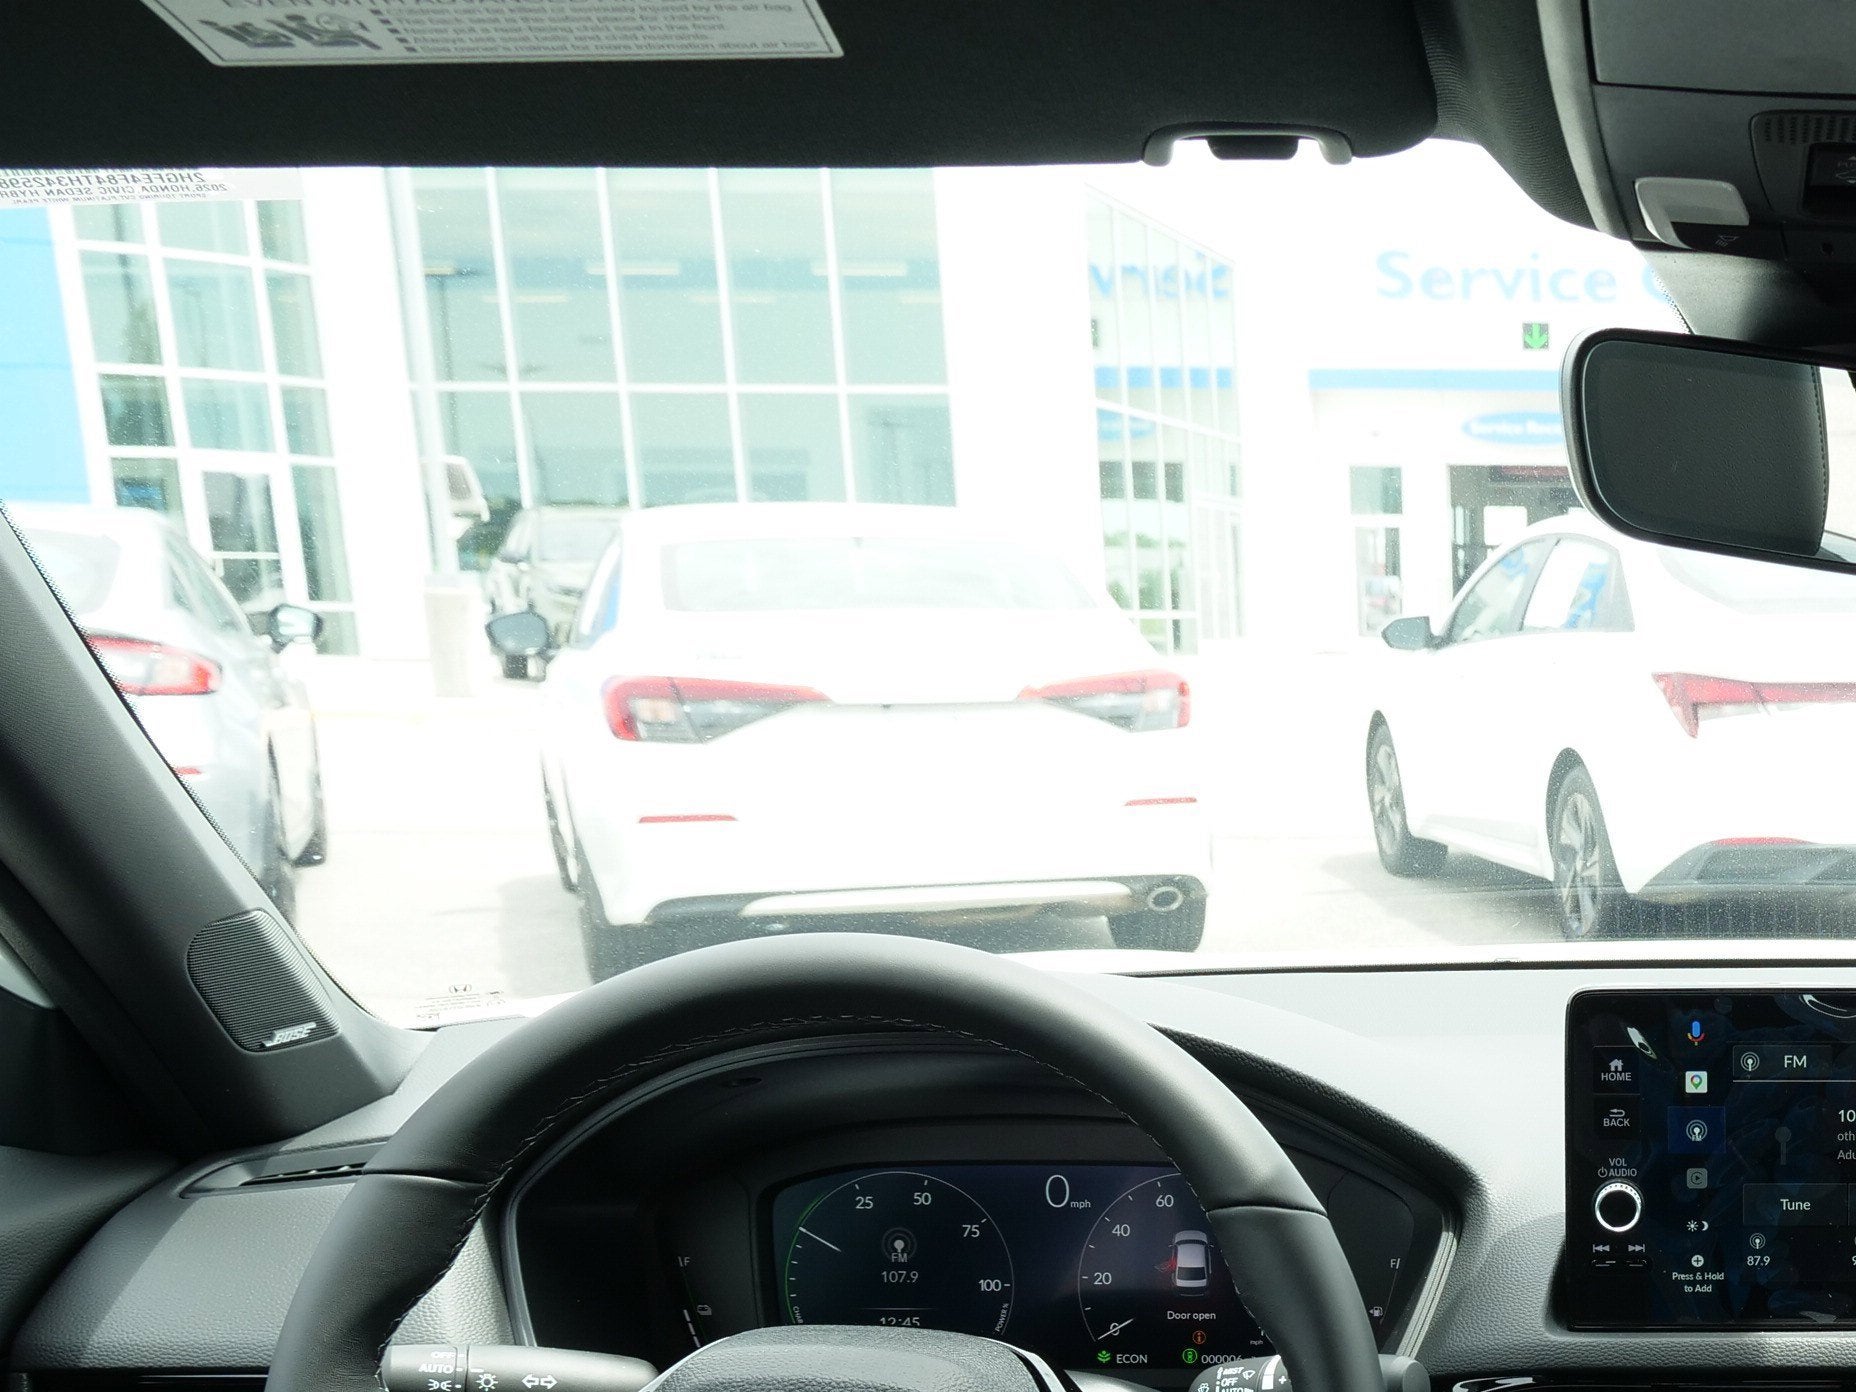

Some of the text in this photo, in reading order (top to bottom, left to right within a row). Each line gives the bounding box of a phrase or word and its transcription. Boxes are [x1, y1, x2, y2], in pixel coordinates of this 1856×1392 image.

[1376, 250, 1617, 303] Service
[261, 1021, 317, 1047] BOSE
[1784, 1055, 1807, 1068] FM
[1601, 1072, 1632, 1082] HOME
[1603, 1118, 1630, 1127] BACK
[1609, 1158, 1627, 1167] VOL
[1609, 1168, 1638, 1178] AUDIO
[1046, 1174, 1091, 1210] 0 mph
[855, 1196, 874, 1209] 25
[913, 1192, 932, 1206] 50
[1155, 1194, 1174, 1208] 60
[1780, 1199, 1812, 1211] Tune
[961, 1224, 980, 1238] 75
[1112, 1224, 1131, 1237] 40
[891, 1252, 908, 1263] FM
[1746, 1256, 1770, 1266] 87.9
[881, 1270, 919, 1284] 107.9
[1093, 1272, 1112, 1285] 20
[1672, 1272, 1725, 1281] Press & Hold
[978, 1279, 1001, 1291] 100
[1684, 1284, 1712, 1293] to Add
[880, 1316, 920, 1327] 12:45
[1167, 1311, 1216, 1321] Door open
[431, 1351, 456, 1359] OFF
[1116, 1354, 1148, 1364] ECON
[419, 1364, 455, 1374] AUTO
[1221, 1377, 1238, 1387] OFF
